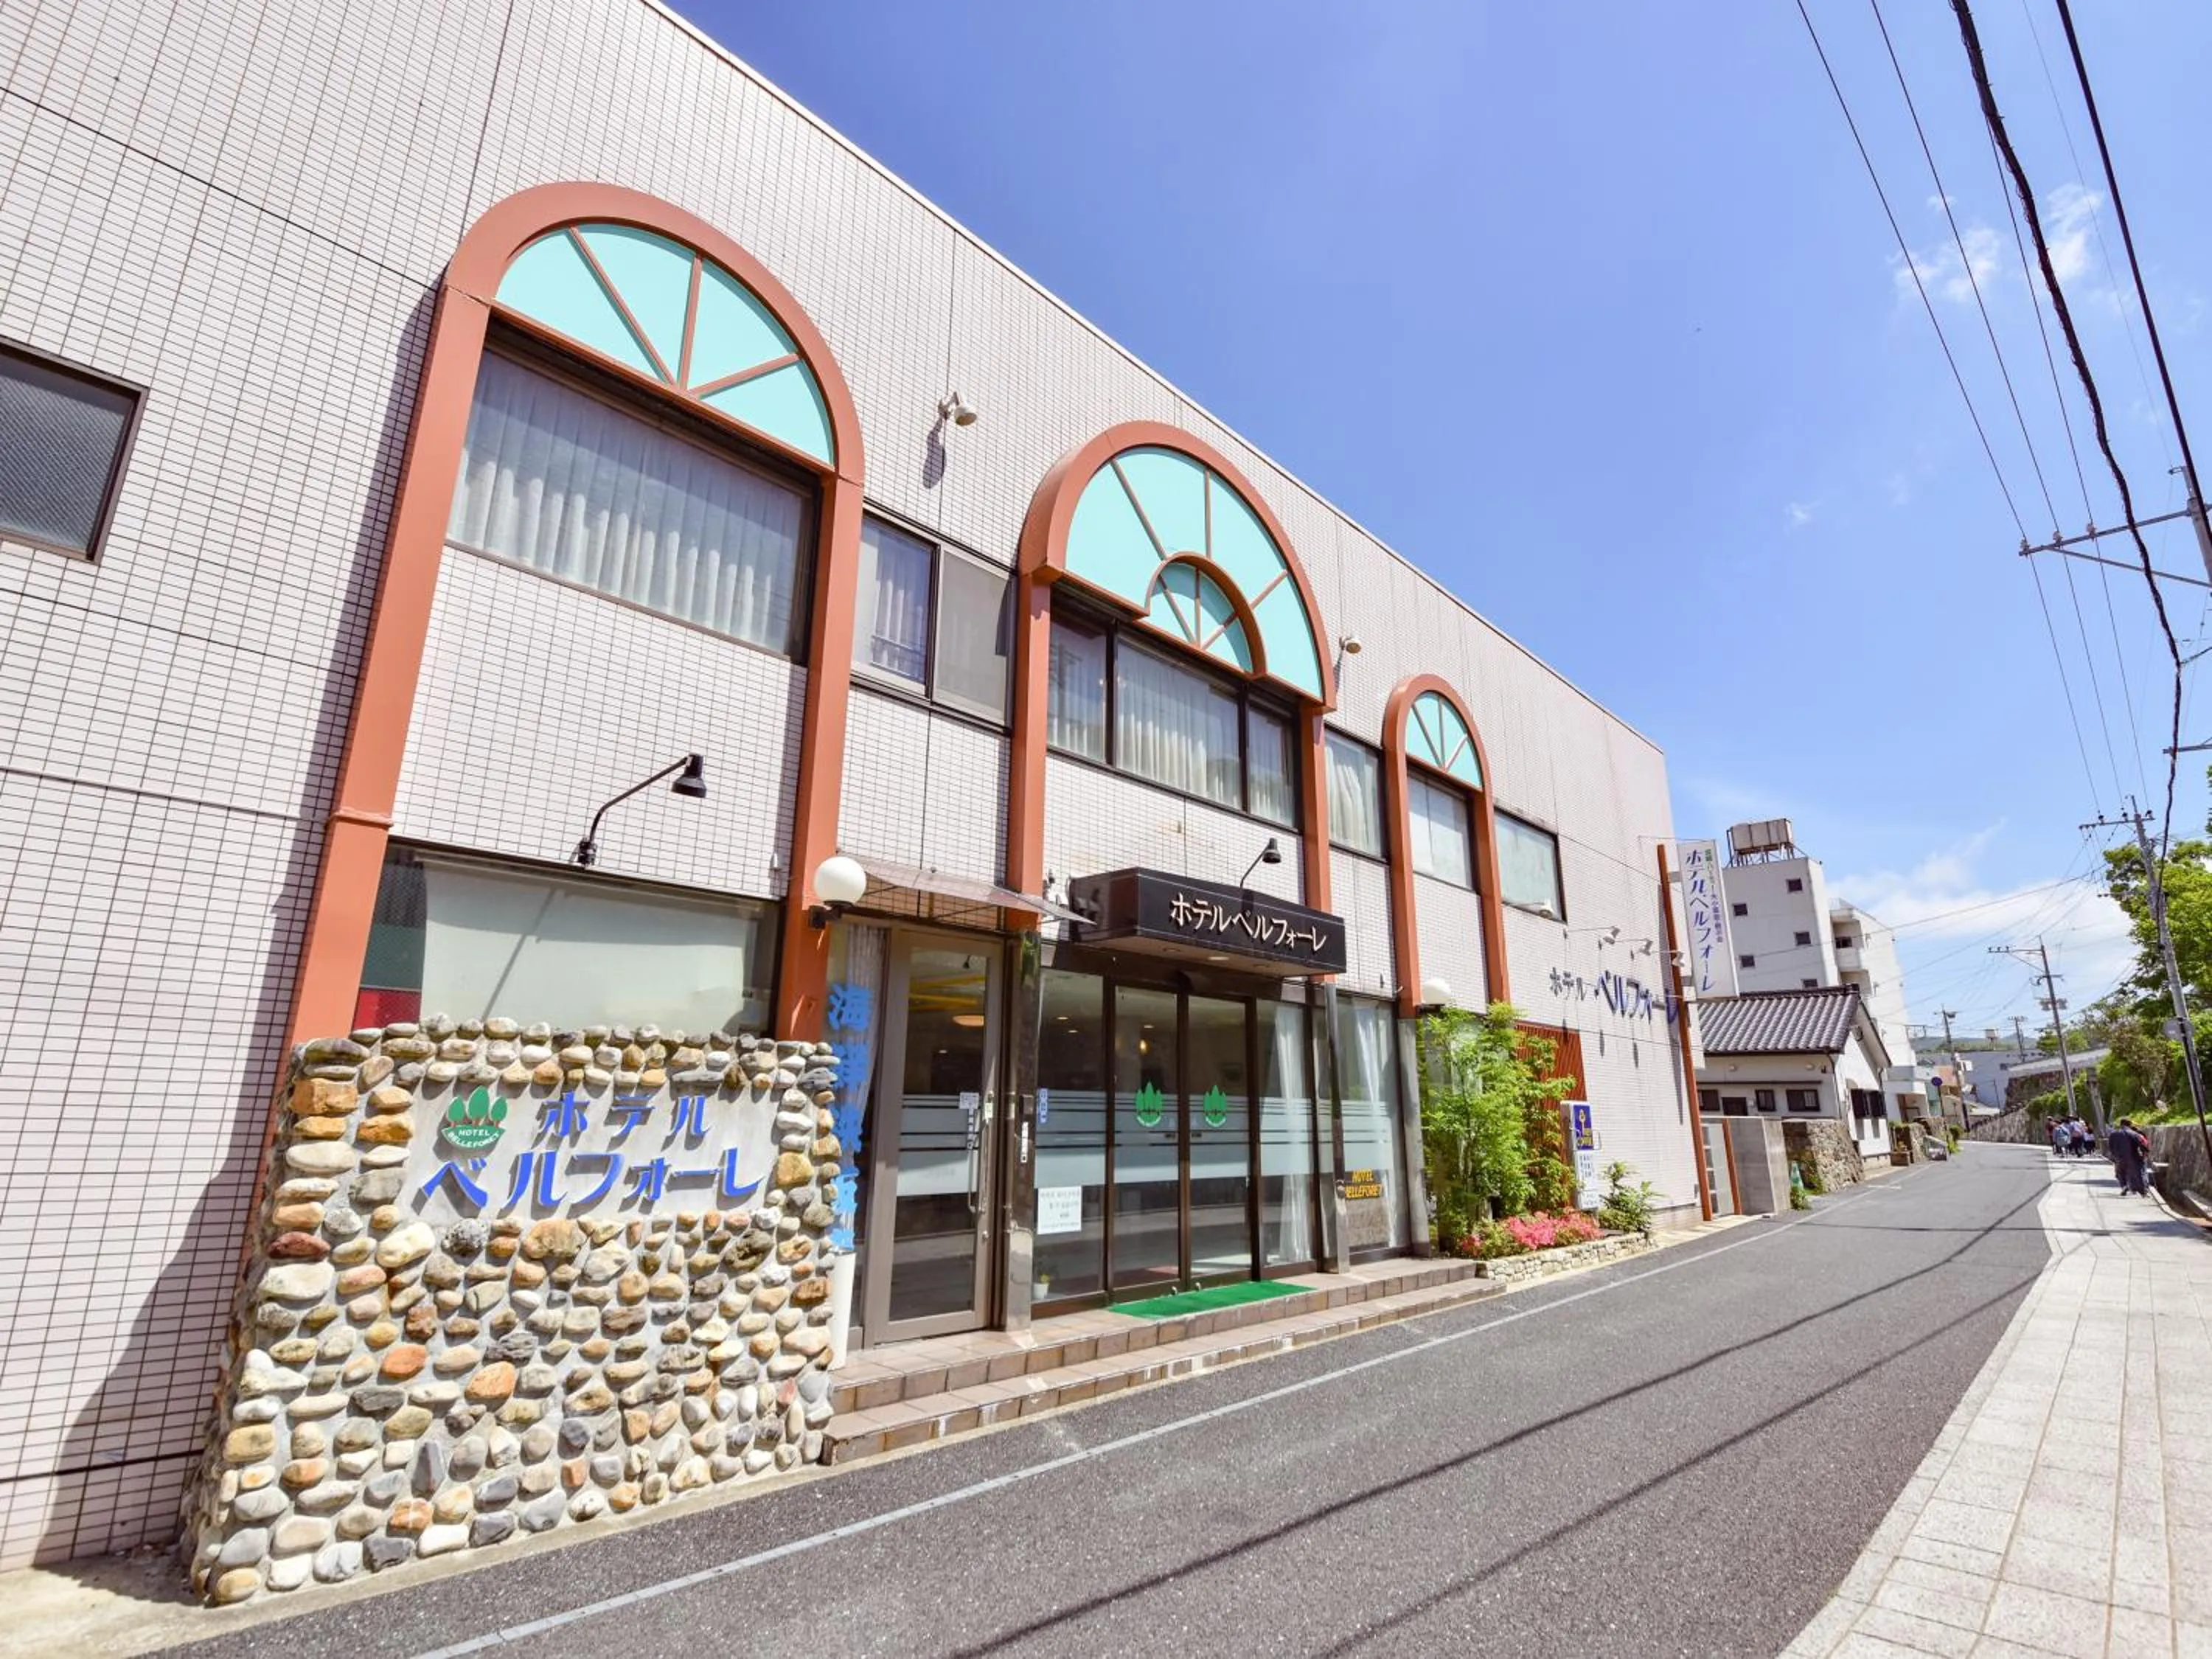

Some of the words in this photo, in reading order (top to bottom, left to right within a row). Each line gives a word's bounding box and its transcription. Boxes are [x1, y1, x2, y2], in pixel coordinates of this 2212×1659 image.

[1169, 892, 1327, 953] ホテルベルフォーレ
[1685, 849, 1716, 992] ホテルベルフォーレ
[538, 1091, 712, 1138] ホテル
[422, 1147, 767, 1209] ベルフォーレ
